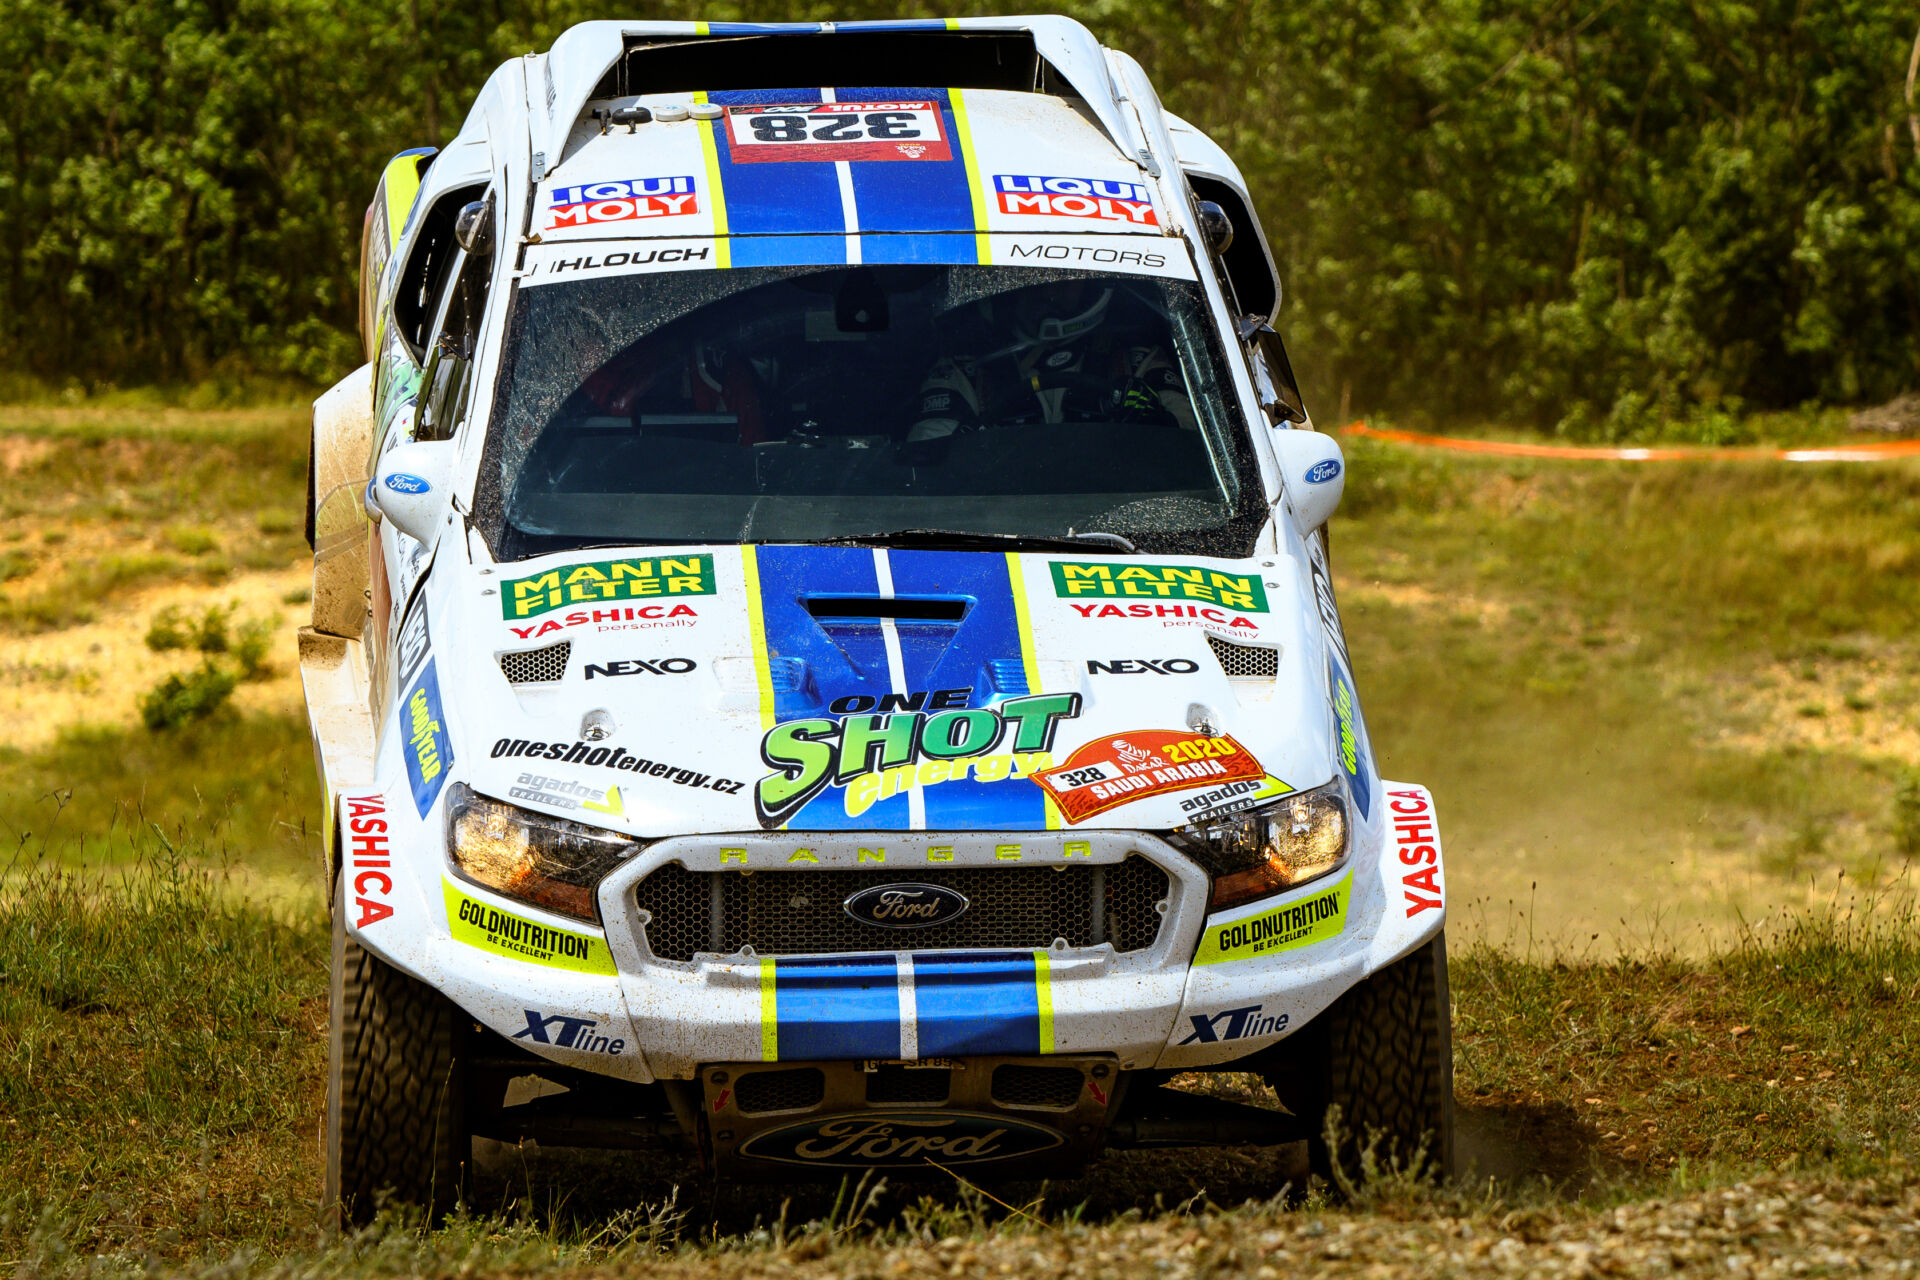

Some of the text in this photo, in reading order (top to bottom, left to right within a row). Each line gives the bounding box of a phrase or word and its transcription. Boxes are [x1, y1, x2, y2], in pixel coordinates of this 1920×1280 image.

[829, 103, 924, 112] MOTUL
[749, 112, 921, 142] 328
[551, 177, 688, 205] LIQUI
[1000, 176, 1150, 203] LIQUI
[547, 194, 694, 227] MOLY
[1004, 193, 1155, 222] MOLY
[556, 247, 709, 273] HLOUCH
[1010, 244, 1166, 268] MOTORS
[922, 395, 951, 411] OMP
[389, 474, 420, 492] Ford
[1313, 462, 1337, 482] Ford
[514, 558, 701, 599] MANN
[1062, 564, 1252, 593] MANN
[515, 576, 705, 616] FILTER
[1066, 580, 1257, 609] FILTER
[510, 604, 698, 639] YASHICA
[598, 619, 697, 633] personally
[1070, 604, 1259, 630] YASHICA
[1163, 620, 1259, 640] personally
[584, 657, 697, 680] NEXO
[1087, 658, 1200, 675] NEXO
[829, 686, 974, 714] ONE
[409, 688, 441, 785] GOODYEAR
[490, 738, 746, 795] oneshotenergy.cz
[754, 692, 1083, 829] SHOT
[1122, 737, 1237, 775] DAKAR 2020
[517, 772, 605, 800] agados
[844, 751, 1053, 818] energy
[1059, 767, 1107, 788] 328
[1090, 759, 1228, 800] SAUDI ARABIA
[510, 789, 576, 809] TRAILERS
[1180, 780, 1261, 811] agados
[1192, 799, 1253, 823] TRAILERS
[347, 794, 394, 929] YASHICA
[720, 840, 1092, 864] RANGER
[1387, 790, 1443, 919] YASHICA
[872, 889, 941, 919] Ford
[458, 898, 589, 961] GOLDNUTRITION
[1219, 896, 1340, 951] GOLDNUTRITION
[486, 933, 553, 961] BE EXCELLENT
[1253, 926, 1313, 952] BE EXCELLENT
[511, 1009, 625, 1056] XTline
[1177, 1004, 1290, 1046] XTline
[795, 1118, 1008, 1160] Ford
